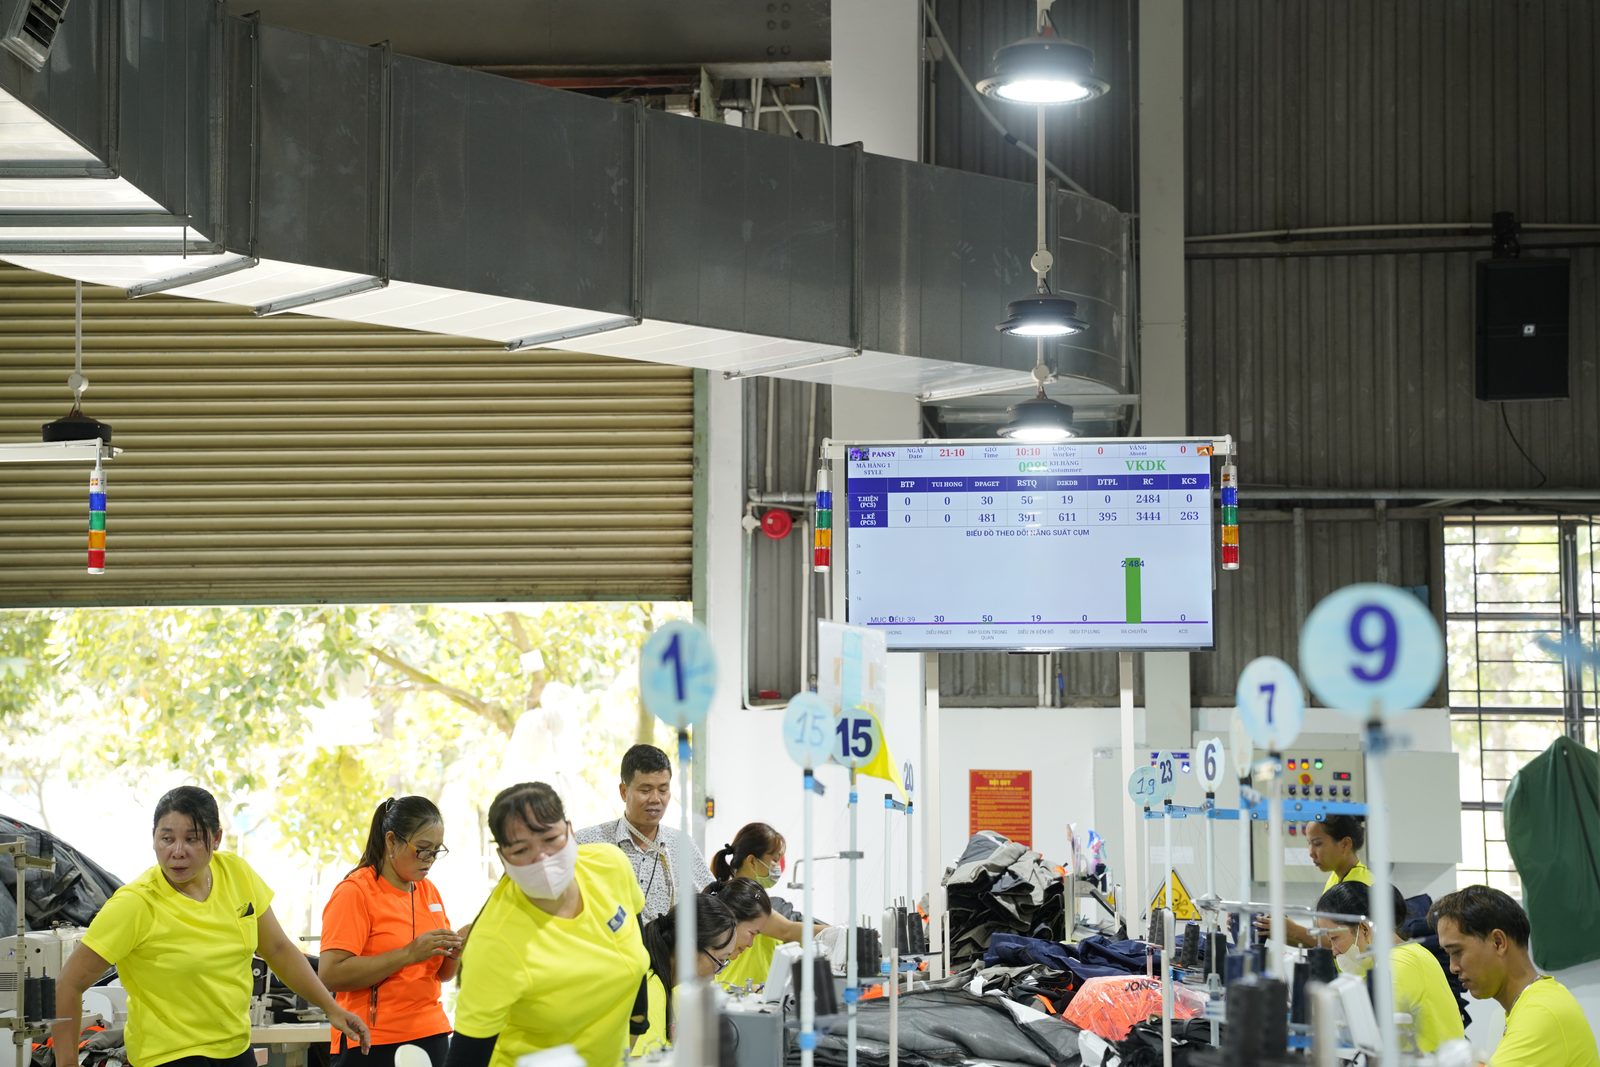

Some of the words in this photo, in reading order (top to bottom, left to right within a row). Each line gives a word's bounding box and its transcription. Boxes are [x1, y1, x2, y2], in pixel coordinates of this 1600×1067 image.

[940, 449, 965, 457] 21-10
[1016, 448, 1041, 456] 10:10
[1097, 447, 1104, 455] 0
[1180, 446, 1187, 454] 0
[1125, 460, 1167, 471] VKDK
[1017, 480, 1037, 488] RSTQ
[904, 497, 911, 506] 0
[944, 496, 951, 505] 0
[980, 496, 993, 505] 30
[1021, 495, 1034, 505] 50
[1061, 495, 1074, 504] 19
[1104, 495, 1111, 504] 0
[1136, 494, 1160, 504] 2484
[1186, 494, 1193, 503] 0
[904, 514, 911, 523] 0
[944, 514, 951, 523] 0
[978, 513, 996, 523] 481
[1018, 513, 1036, 522] 391
[1058, 512, 1076, 522] 611
[1098, 512, 1117, 521] 395
[1136, 511, 1161, 521] 3444
[1180, 511, 1199, 521] 263
[996, 529, 1015, 537] THEO
[934, 615, 945, 623] 30
[1031, 614, 1042, 622] 19
[1081, 614, 1088, 622] 0
[1347, 603, 1399, 684] 9
[660, 630, 685, 702] 1
[1258, 683, 1276, 725] 7
[794, 711, 826, 747] 15
[836, 717, 873, 758] 15
[1204, 743, 1217, 781] 6
[1159, 759, 1173, 784] 23
[903, 761, 914, 792] 20
[1135, 777, 1156, 795] 19
